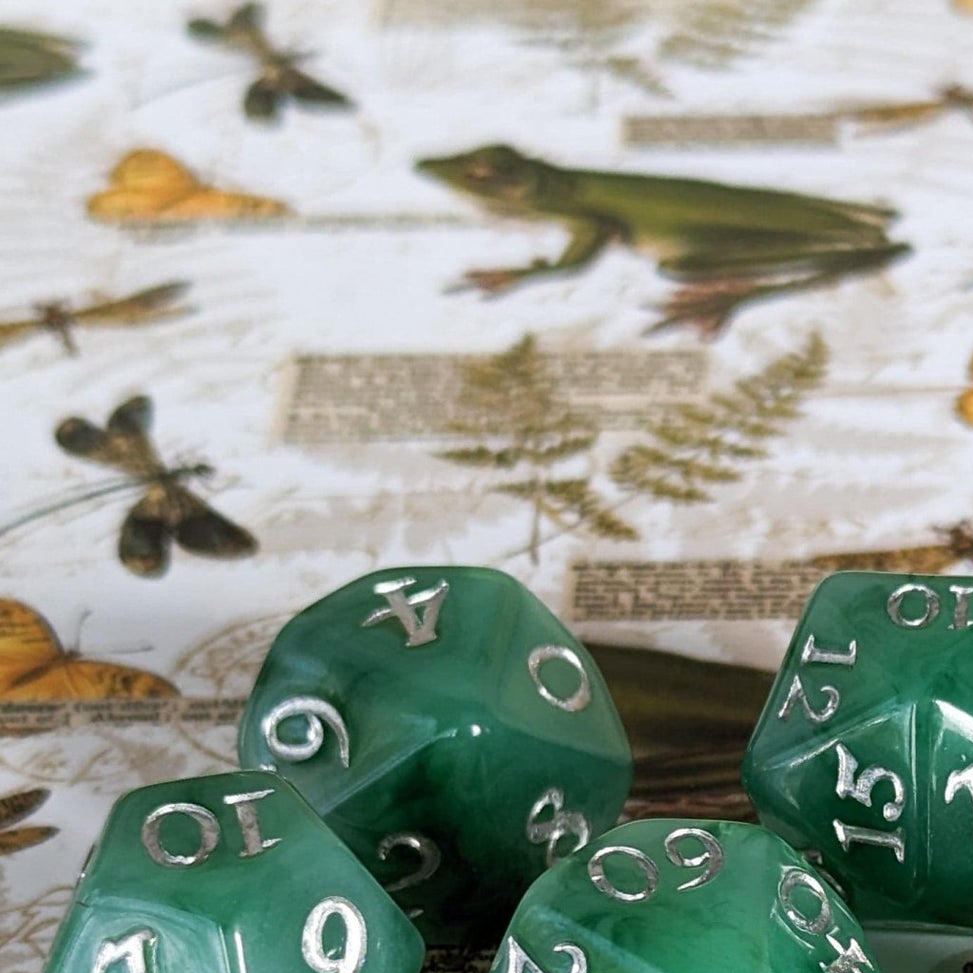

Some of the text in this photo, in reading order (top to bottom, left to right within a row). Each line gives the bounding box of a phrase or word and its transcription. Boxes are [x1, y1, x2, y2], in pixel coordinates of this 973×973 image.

[361, 577, 449, 647] 4
[528, 645, 591, 712] 0
[778, 634, 857, 723] 12
[140, 789, 283, 868] 10
[833, 743, 905, 864] 15
